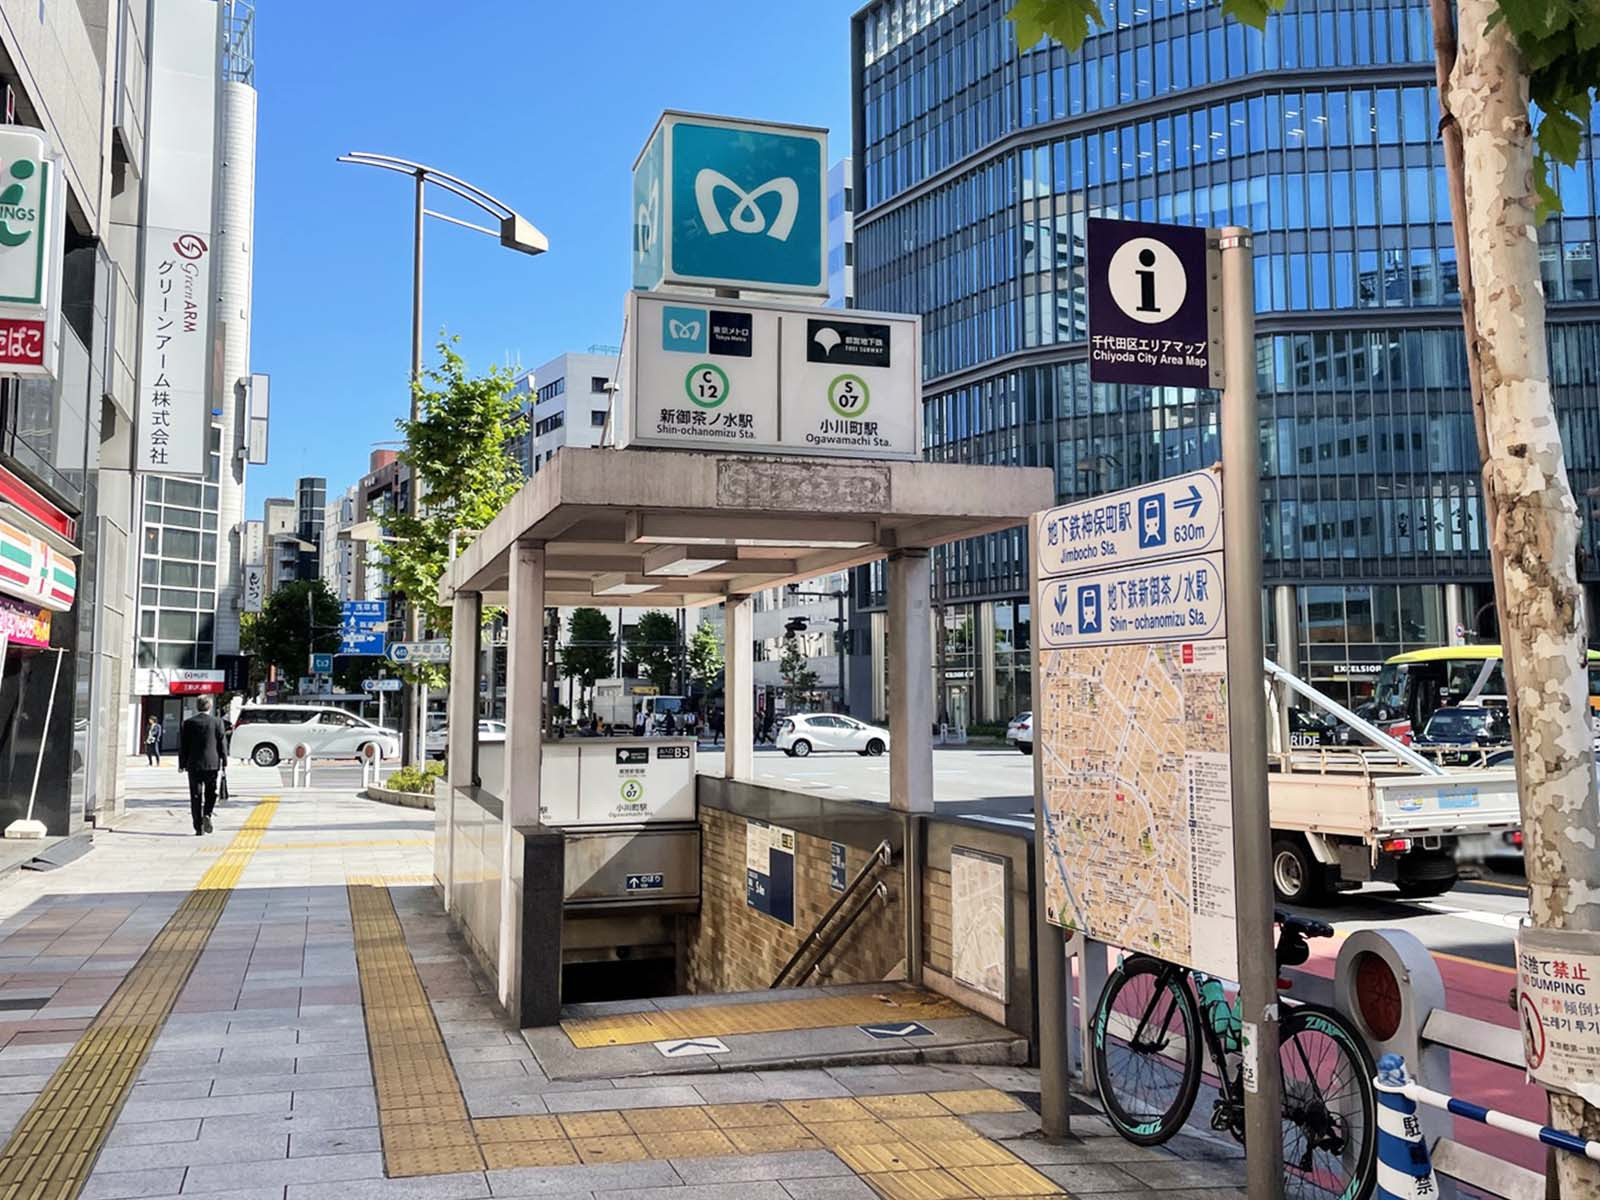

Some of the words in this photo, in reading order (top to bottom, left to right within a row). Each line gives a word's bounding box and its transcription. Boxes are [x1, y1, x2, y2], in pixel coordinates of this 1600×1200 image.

[713, 325, 749, 337] 東京メトロ
[1092, 335, 1207, 354] 千代田区エリアマップ
[149, 259, 176, 465] グリーンアーム株式会社
[1093, 350, 1136, 363] Chiyoda
[1137, 352, 1157, 365] City
[1160, 355, 1184, 365] Area
[1185, 356, 1207, 368] Map
[703, 371, 712, 383] C
[698, 385, 718, 399] 12
[844, 381, 853, 394] S
[838, 395, 859, 408] 07
[660, 408, 753, 429] 新御茶ノ水駅
[656, 424, 737, 438] Shin-ochanomizu
[738, 429, 756, 439] Sta.
[819, 419, 878, 436] 小川町駅
[806, 433, 870, 447] Ogawamachi
[871, 436, 891, 447] Sta.
[1047, 502, 1132, 546] 地下鉄神保町駅
[1173, 525, 1205, 543] 630m
[1060, 545, 1097, 564] Jimbocho
[1101, 541, 1117, 556] Sta.
[1107, 569, 1208, 611] 地下鉄新御茶ノ水駅
[1189, 609, 1207, 625] Sta.
[1050, 622, 1073, 637] 140m
[1290, 735, 1320, 746] RIDE
[626, 790, 637, 798] 07
[616, 803, 648, 812] 小川町駅
[1530, 975, 1586, 996] DUMPING
